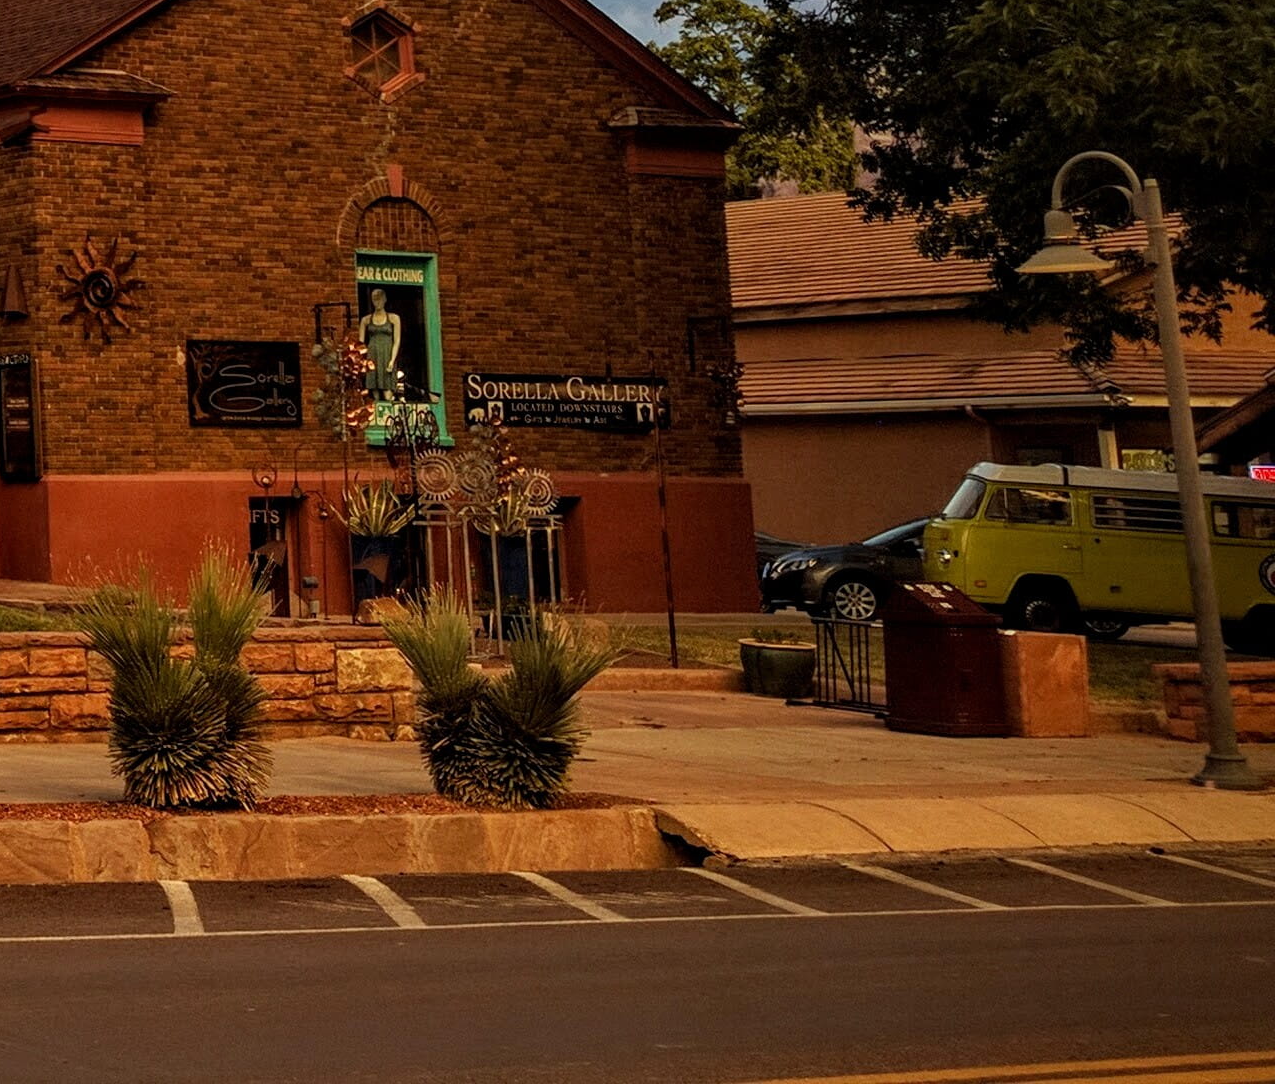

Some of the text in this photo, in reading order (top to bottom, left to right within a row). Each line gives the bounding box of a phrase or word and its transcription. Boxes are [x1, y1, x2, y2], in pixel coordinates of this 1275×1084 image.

[382, 267, 425, 284] CLOTHING
[467, 374, 560, 401] SORELLA
[511, 402, 623, 414] LOCATED DOWNSTAIRS
